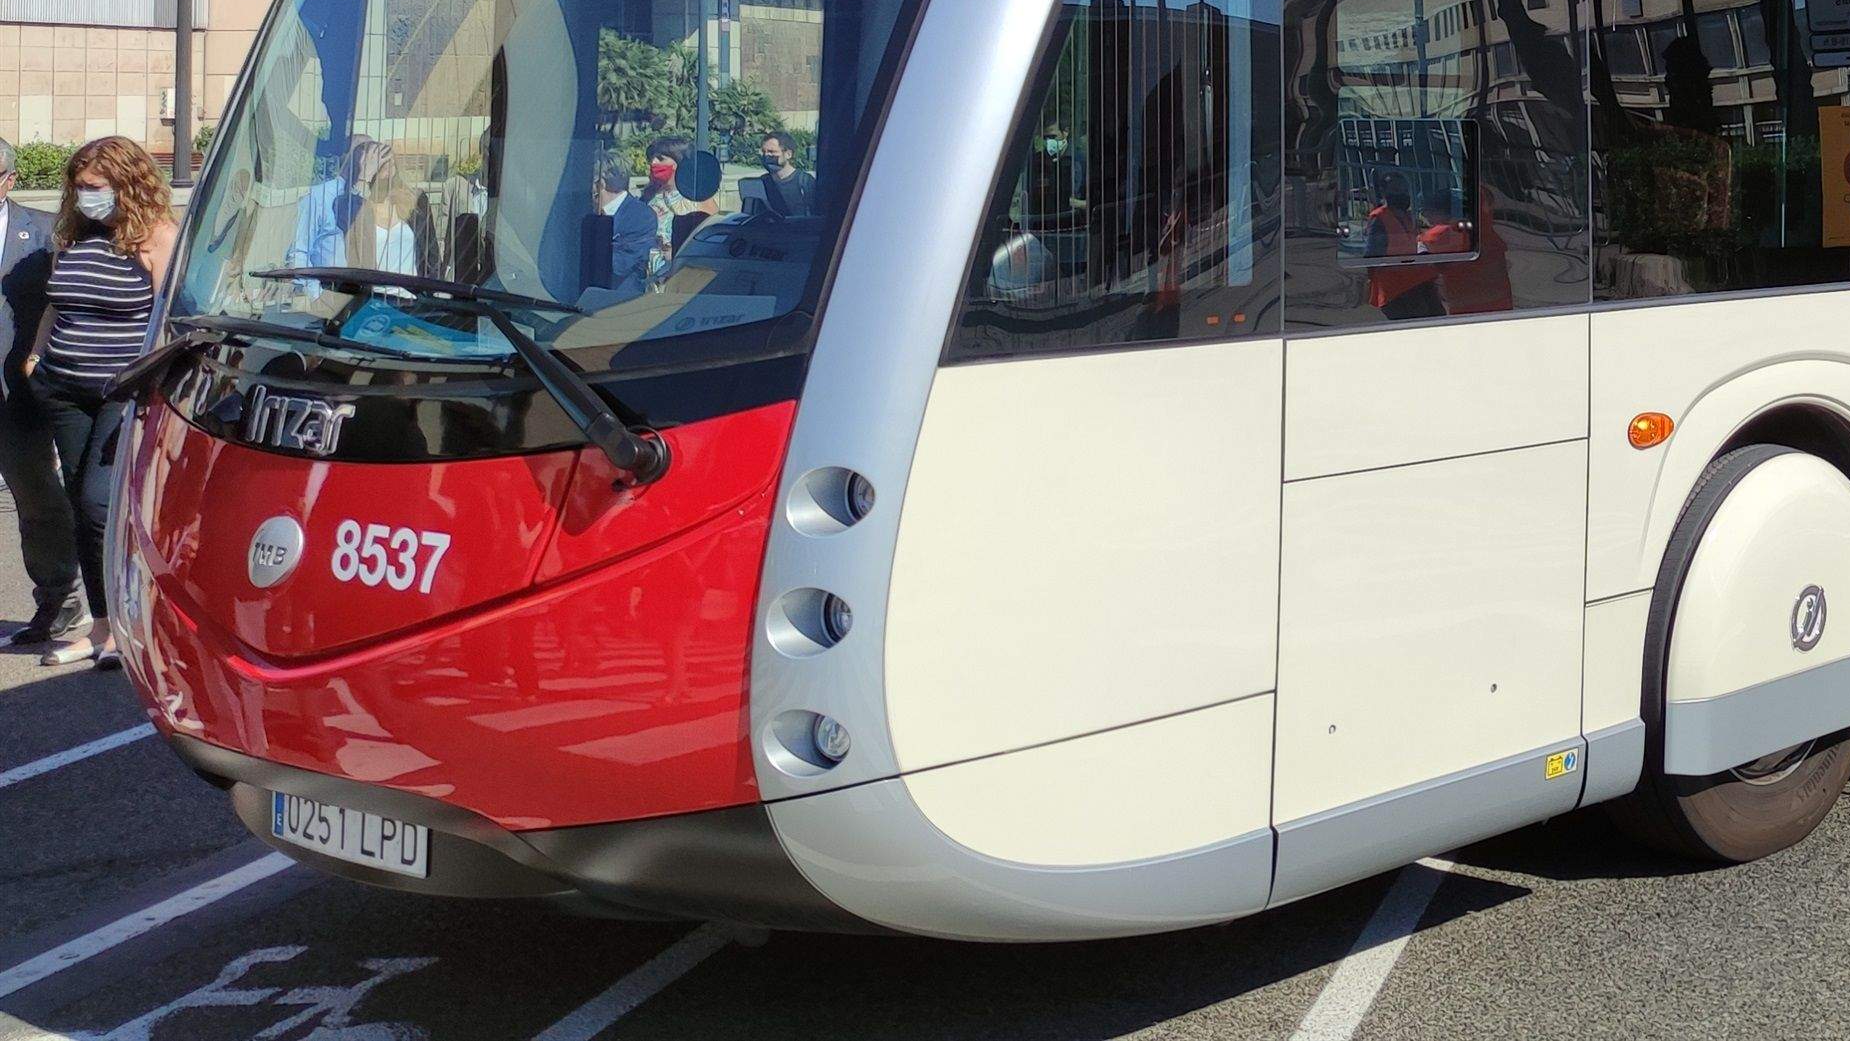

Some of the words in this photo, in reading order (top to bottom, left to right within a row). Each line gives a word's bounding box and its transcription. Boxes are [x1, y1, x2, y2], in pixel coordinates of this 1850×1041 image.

[331, 519, 451, 594] 8537
[288, 795, 347, 850] 0251
[360, 811, 418, 867] LPD
